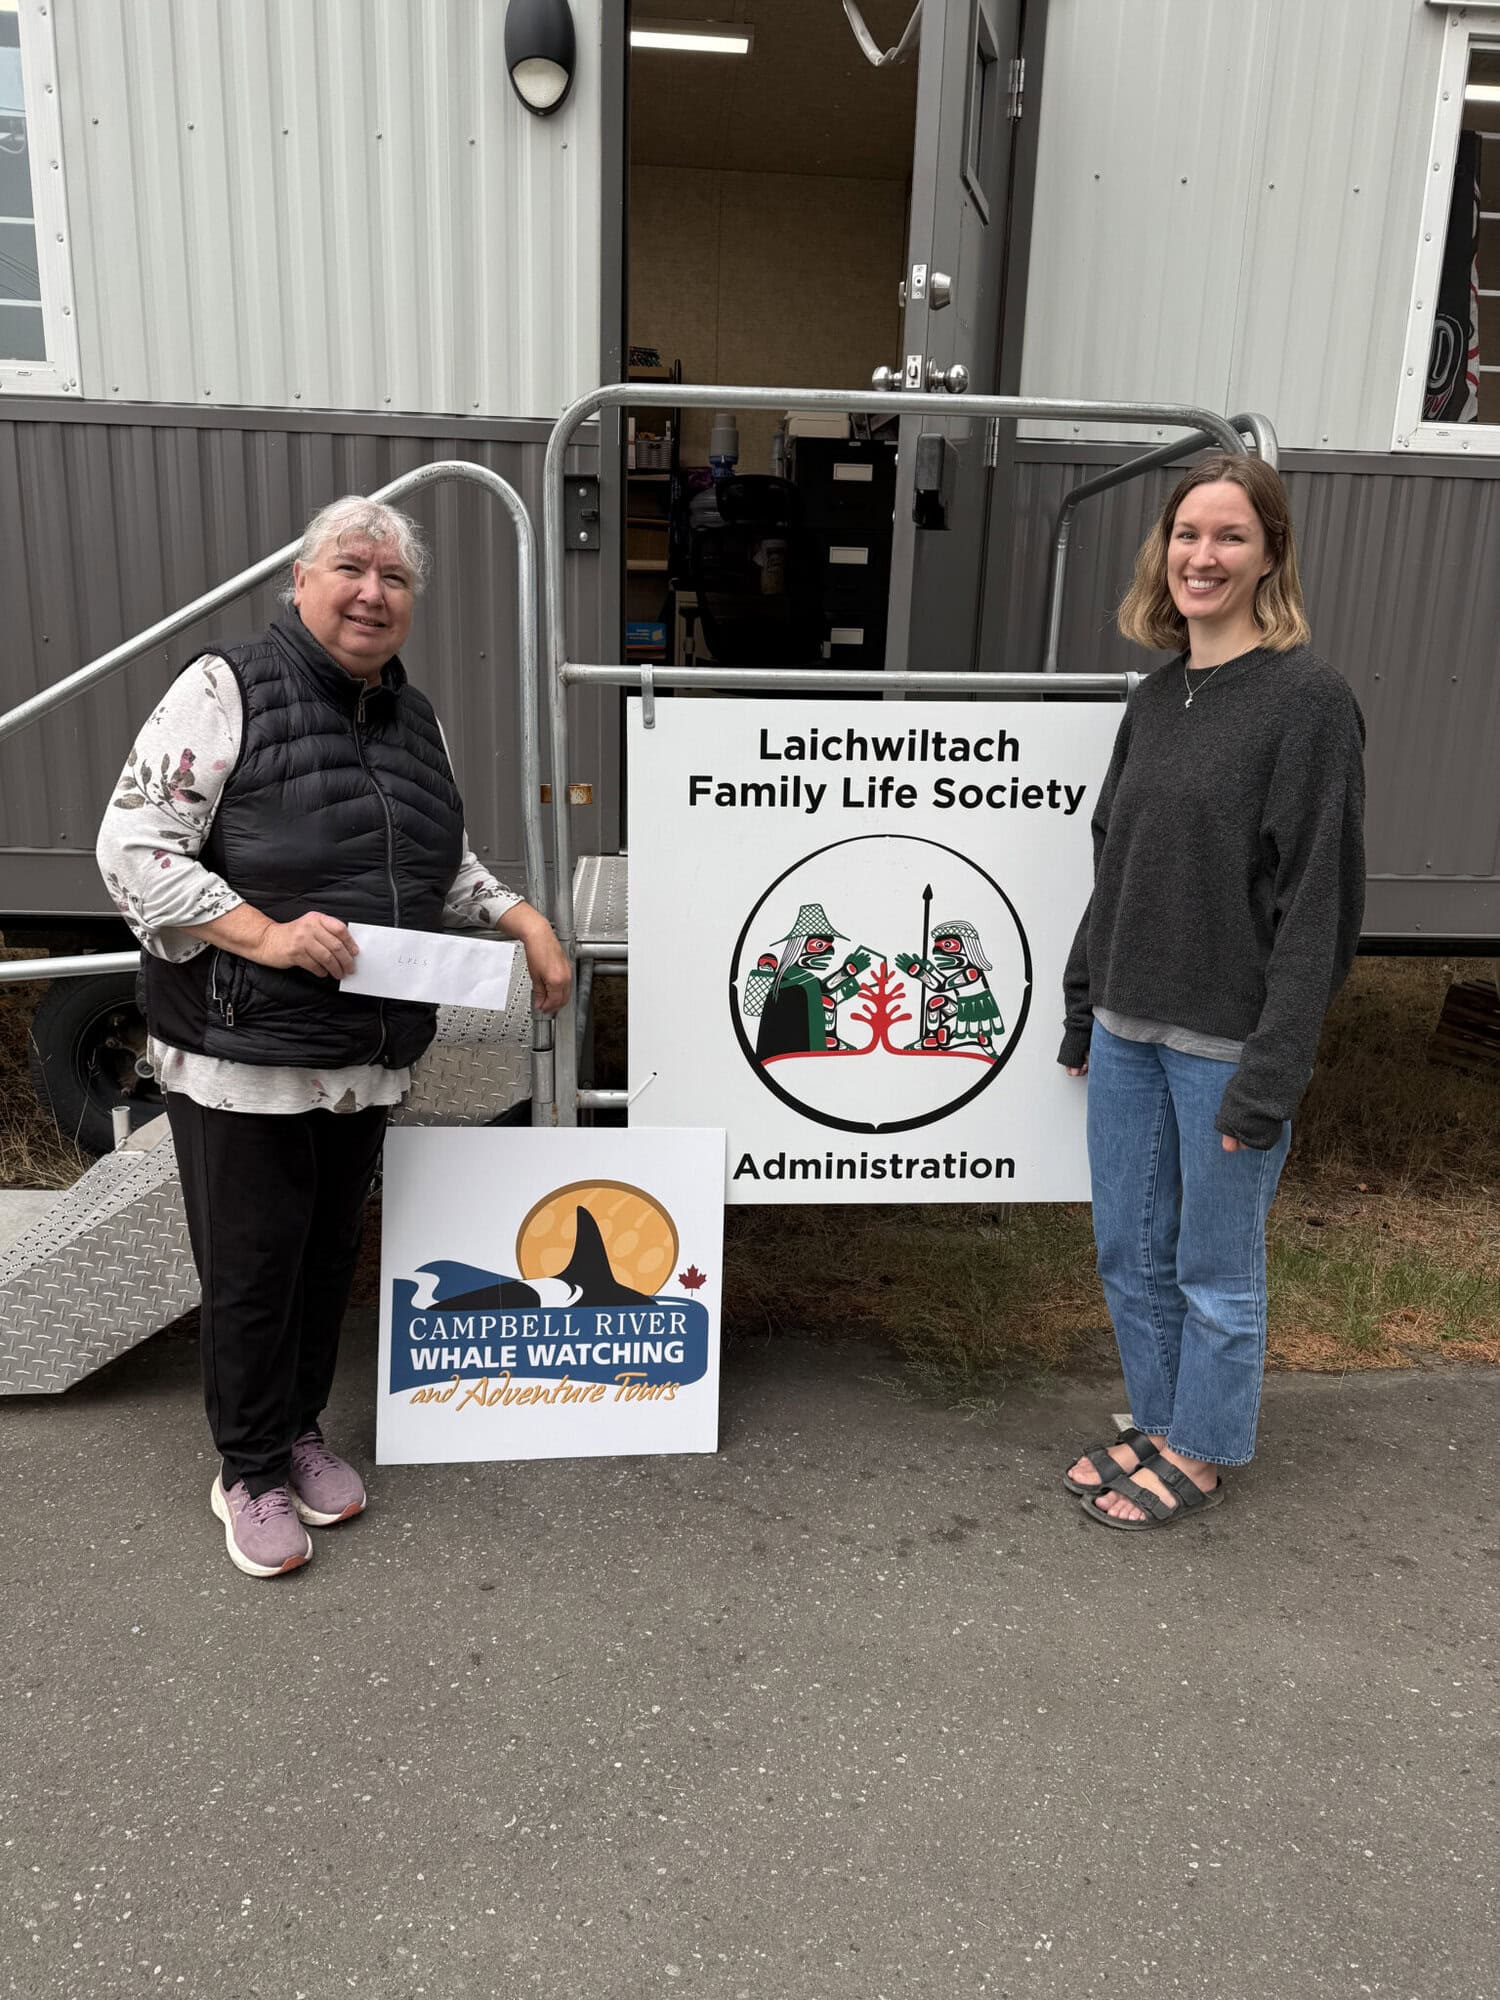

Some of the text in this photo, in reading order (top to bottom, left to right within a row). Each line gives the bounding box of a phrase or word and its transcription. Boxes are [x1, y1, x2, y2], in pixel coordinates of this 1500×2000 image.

[760, 728, 1020, 762] Laichwiltach
[689, 775, 1087, 815] Family Life Society
[732, 1152, 1016, 1180] Administration
[409, 1312, 687, 1341] CAMPBELL RIVER
[410, 1342, 684, 1370] WHALE WATCHING
[410, 1371, 681, 1411] and Adventure Tours
